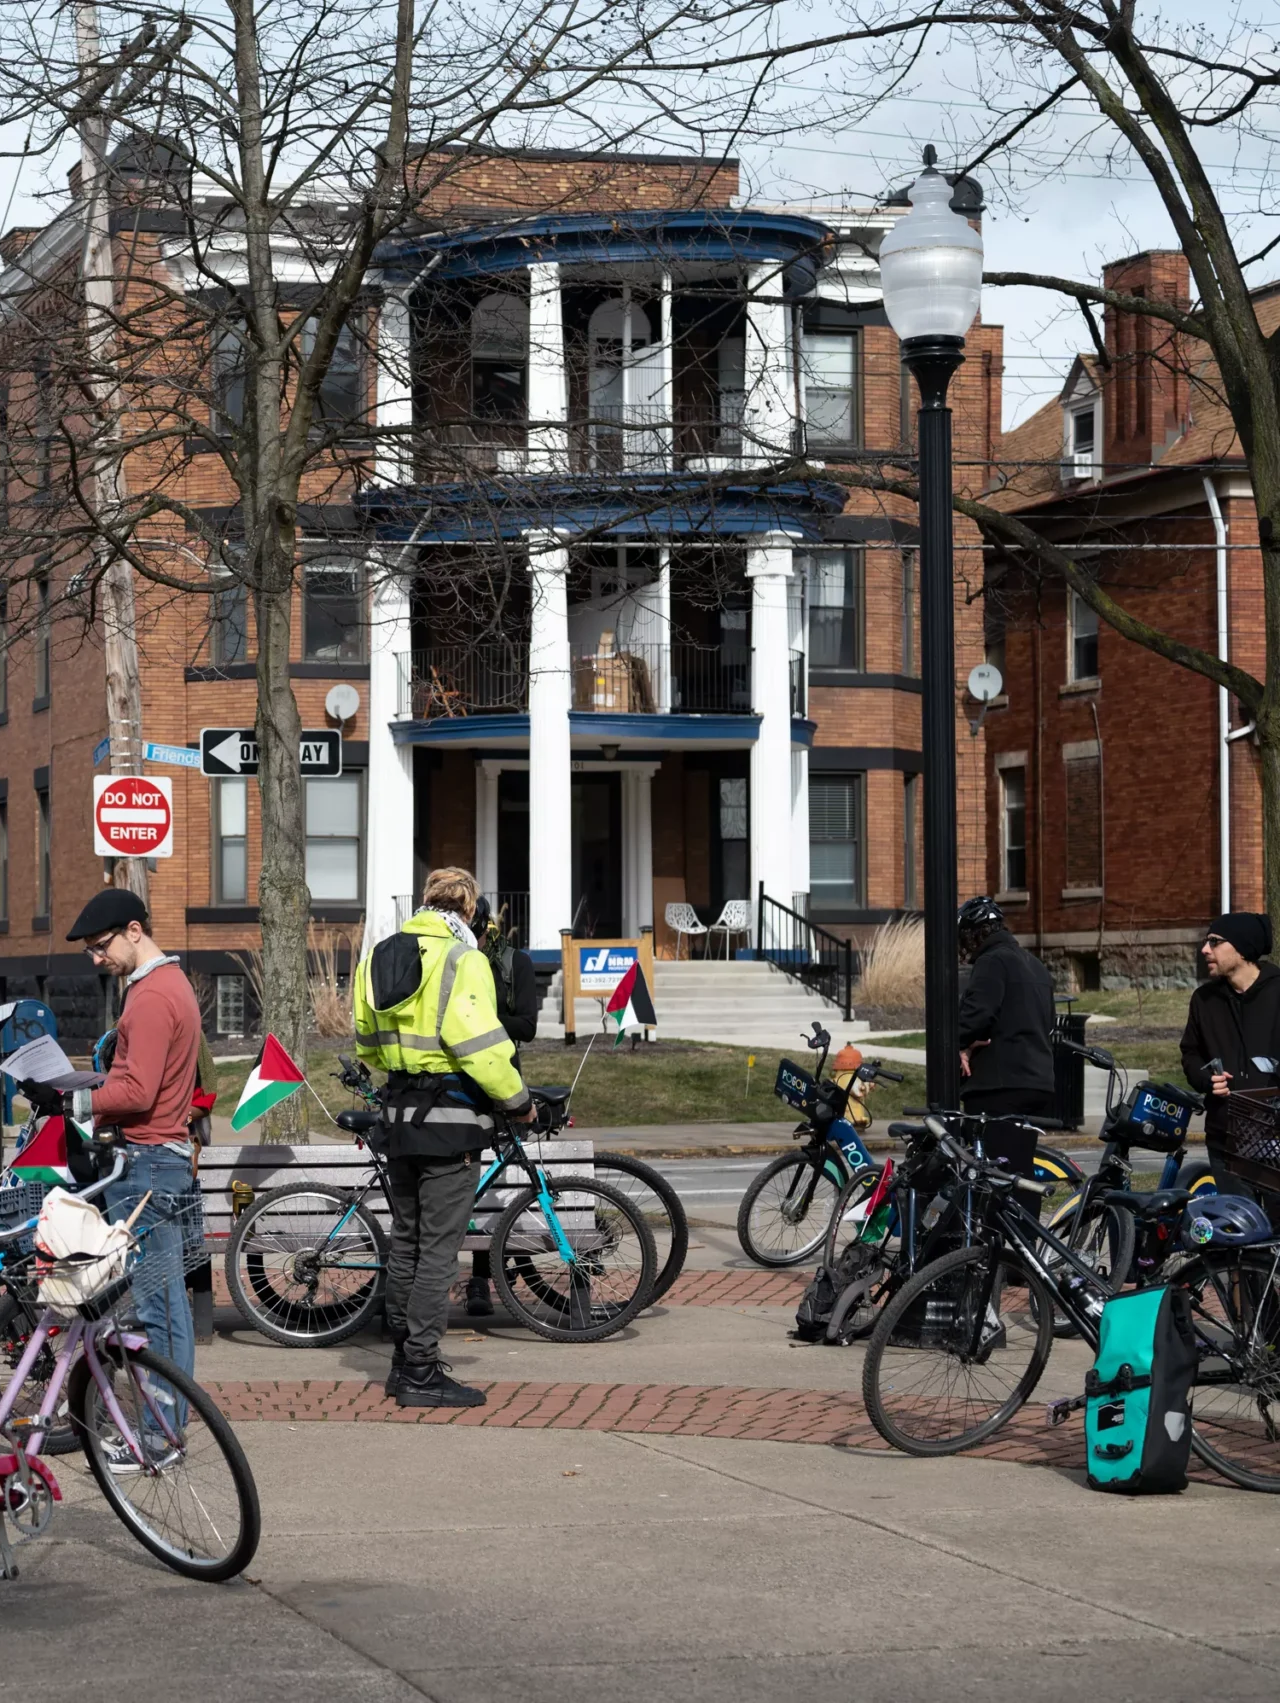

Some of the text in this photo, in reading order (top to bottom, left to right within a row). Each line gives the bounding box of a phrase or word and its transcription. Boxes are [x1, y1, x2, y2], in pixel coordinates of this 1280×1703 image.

[152, 746, 200, 764] Friends
[240, 743, 323, 761] ON AY
[104, 792, 161, 806] DO NOT
[110, 826, 157, 840] ENTER
[782, 1069, 807, 1093] POGOH
[1143, 1093, 1184, 1119] POGOH
